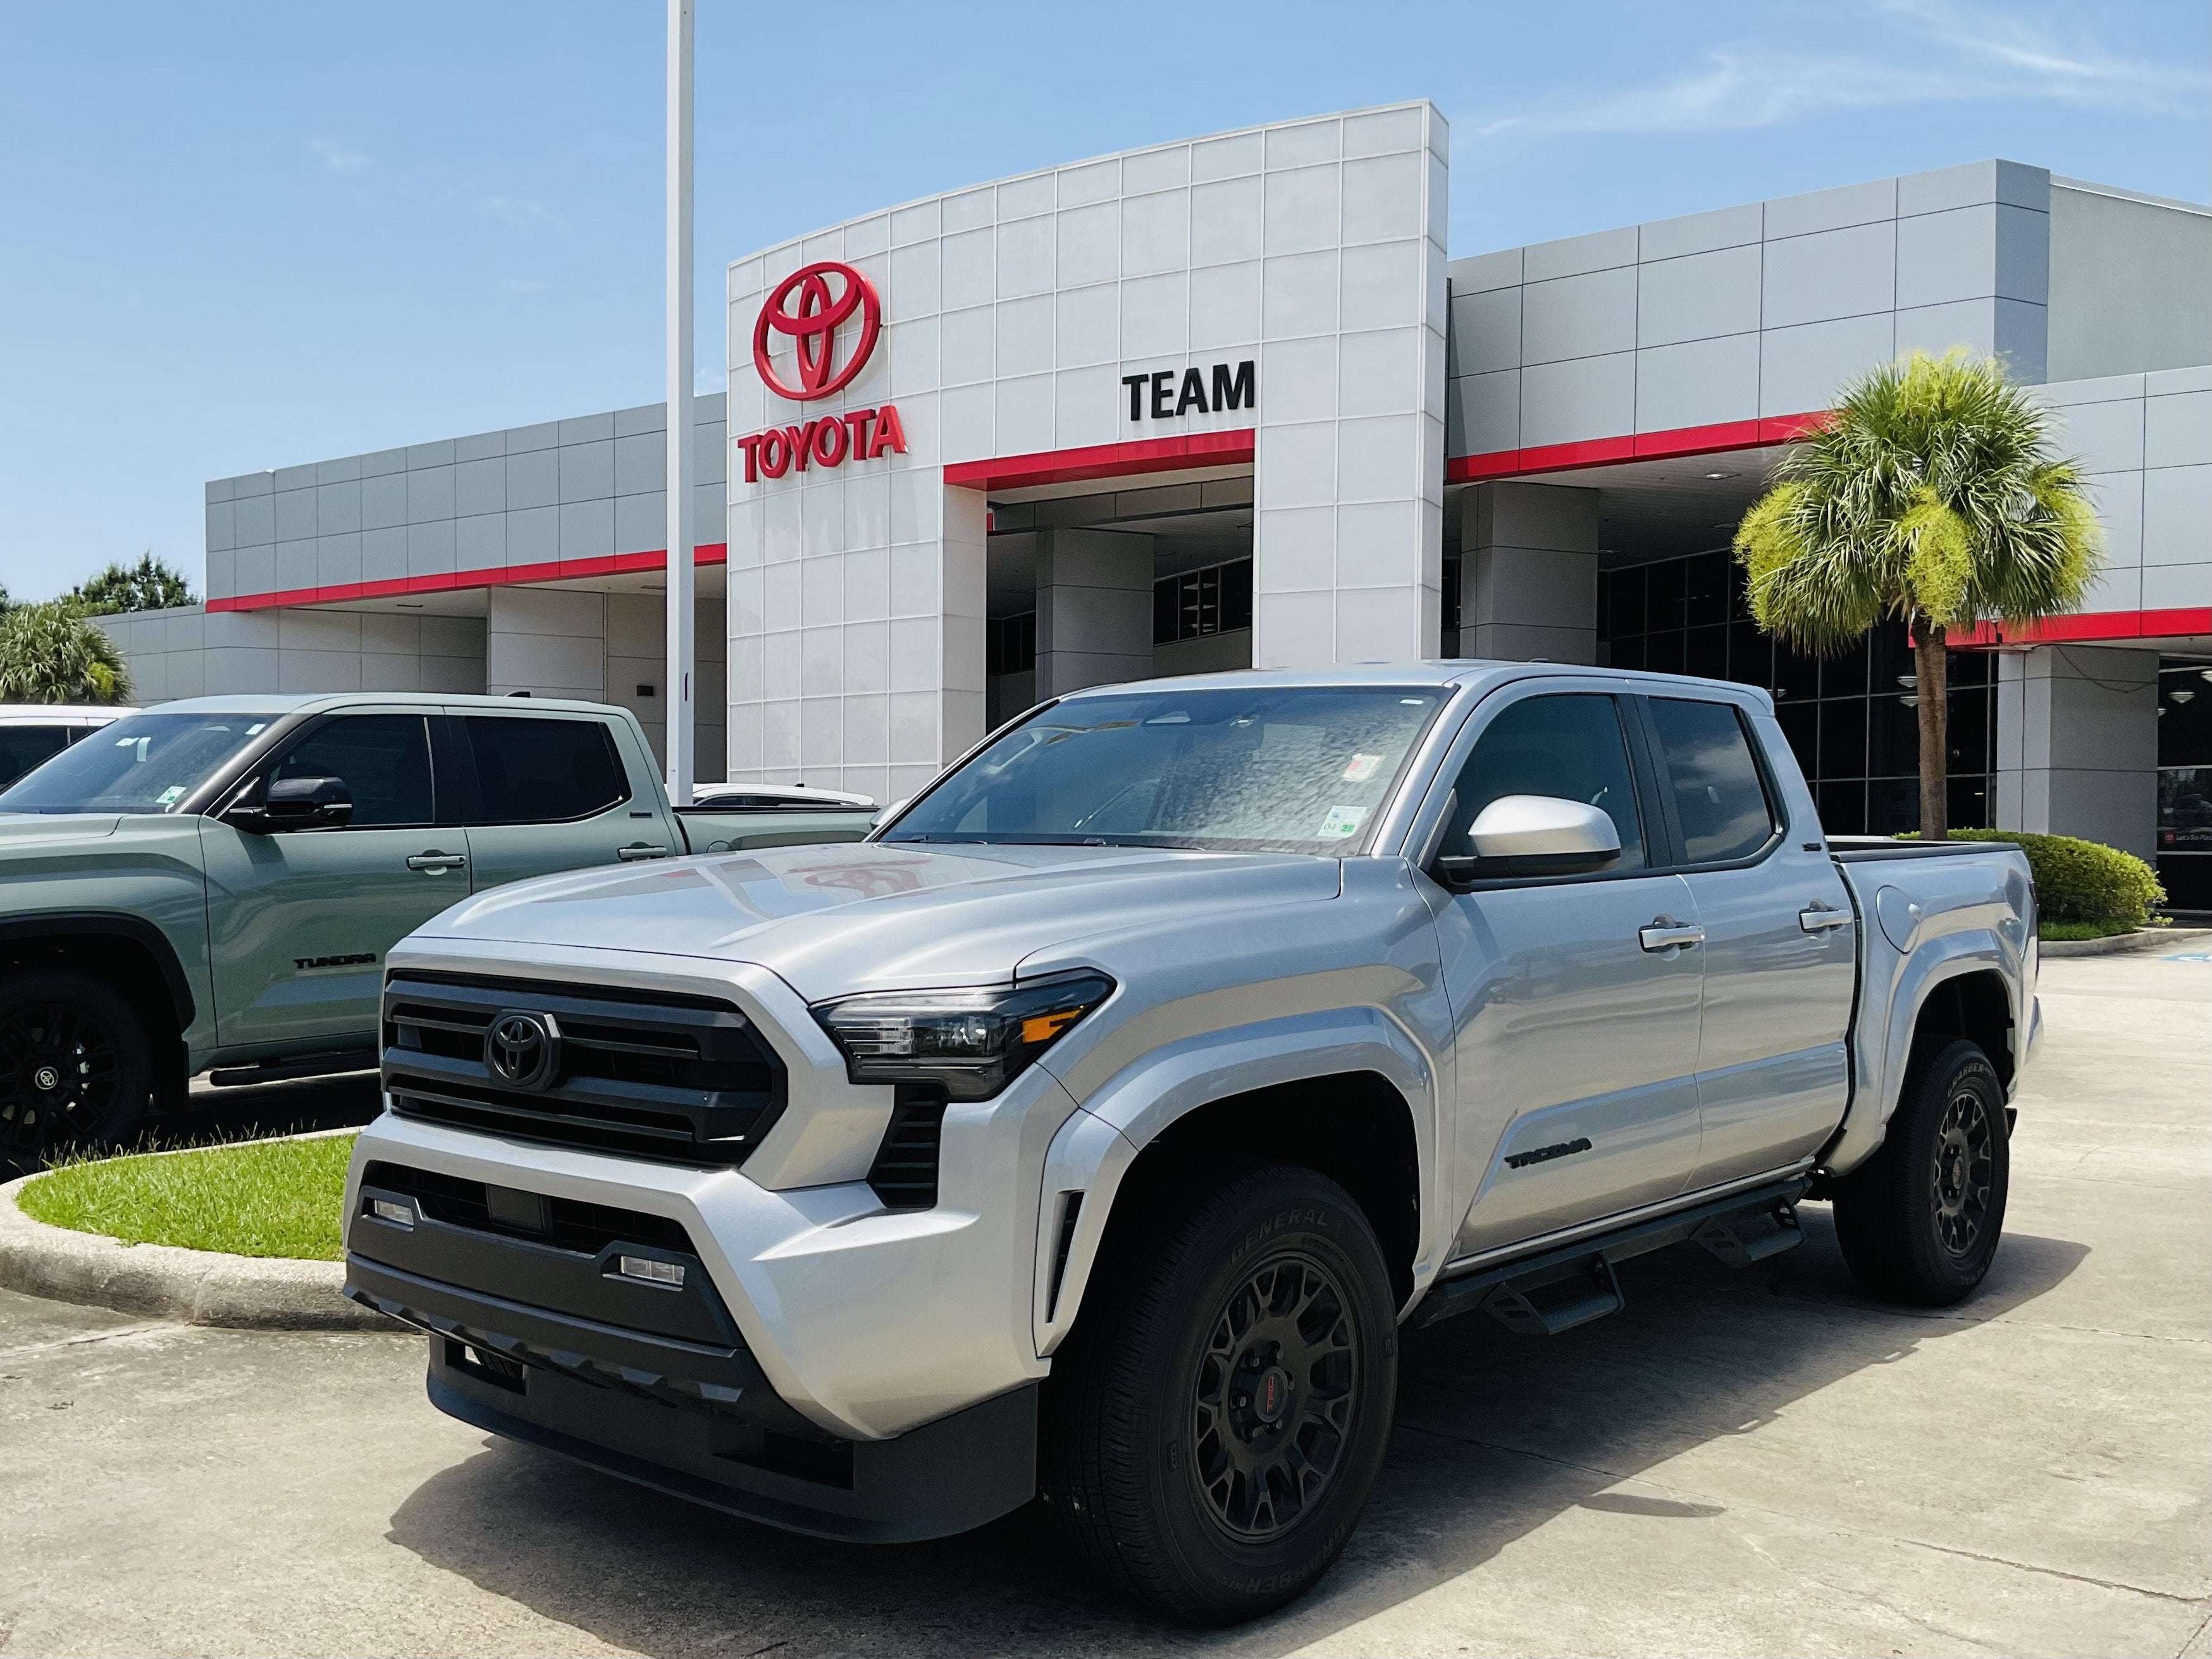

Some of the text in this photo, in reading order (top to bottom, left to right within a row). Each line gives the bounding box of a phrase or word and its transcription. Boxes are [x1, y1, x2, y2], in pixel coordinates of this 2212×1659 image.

[1121, 360, 1255, 422] TEAM
[738, 405, 908, 483] TOYOTA
[293, 953, 376, 969] TUNDRA
[1504, 1137, 1592, 1169] TACOMA
[1230, 1208, 1327, 1266] GENERAL
